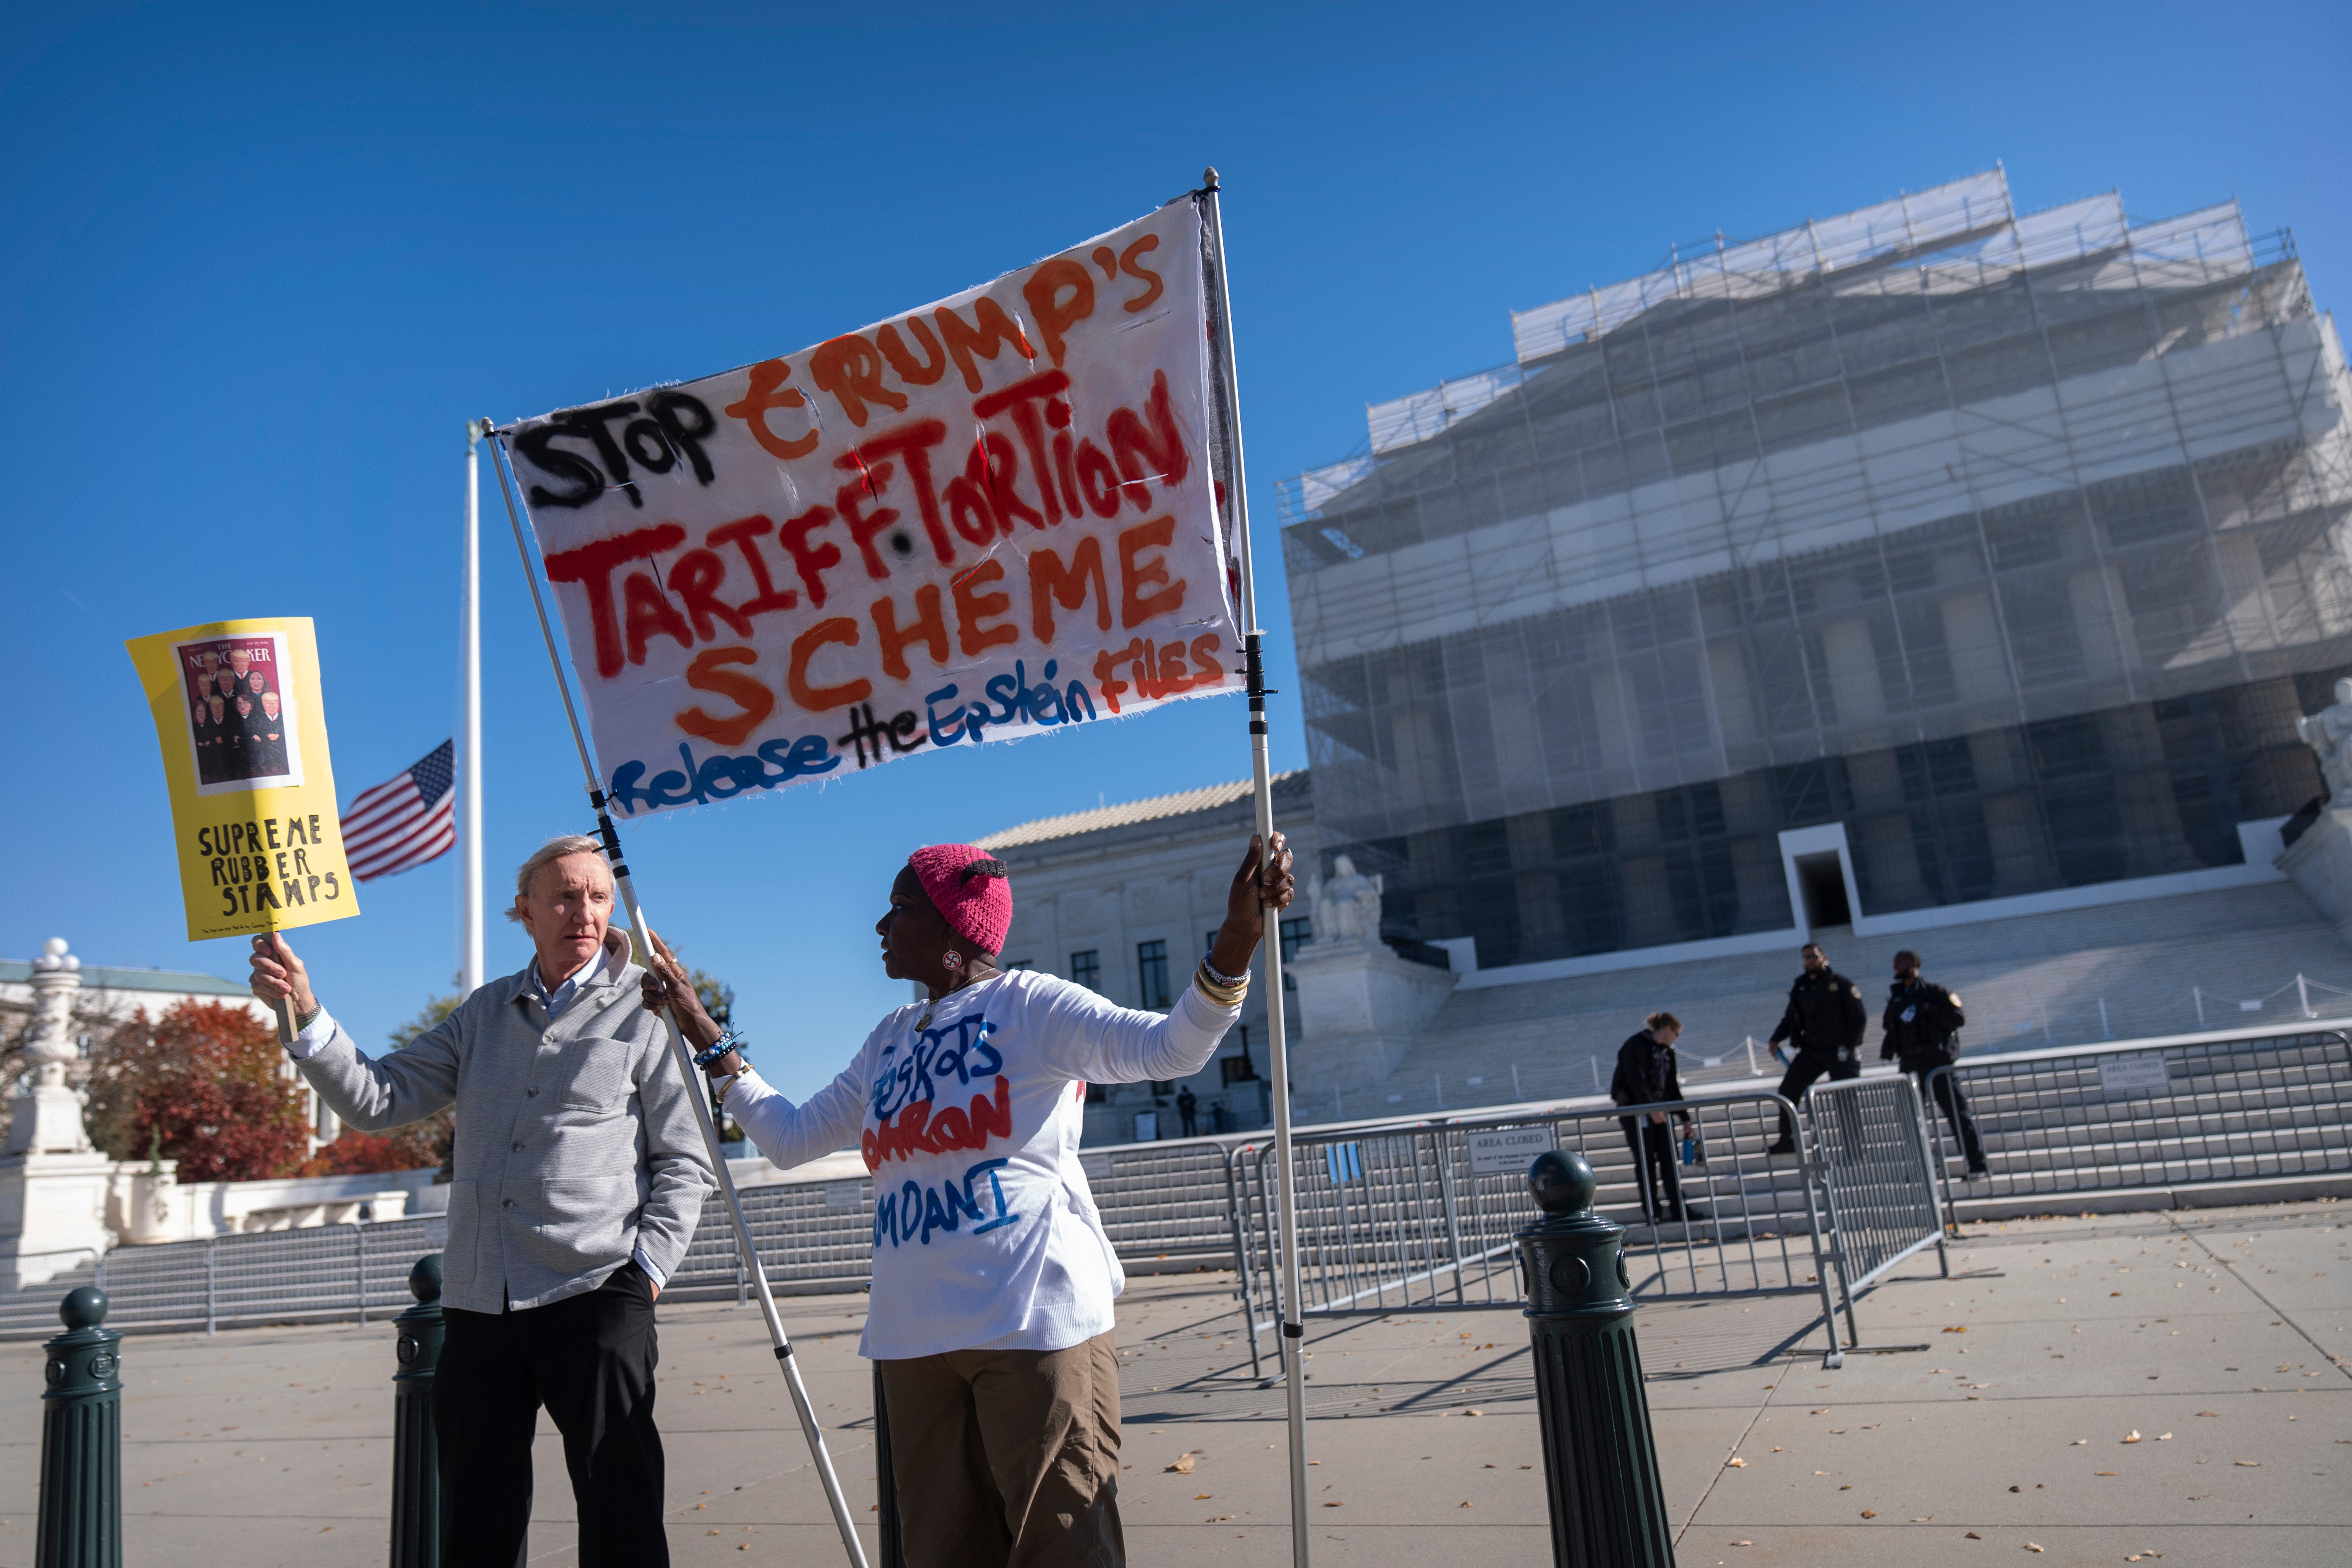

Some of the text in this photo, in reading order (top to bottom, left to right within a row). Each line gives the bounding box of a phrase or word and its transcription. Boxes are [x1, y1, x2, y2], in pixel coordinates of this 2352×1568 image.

[674, 515, 1187, 746] SCHEME
[189, 653, 206, 668] NE
[837, 703, 927, 769] the
[199, 815, 321, 856] SUPREME
[211, 848, 311, 886] RUBBER
[223, 872, 339, 917] STAMPS
[1476, 1134, 1542, 1149] AREA CLOSED
